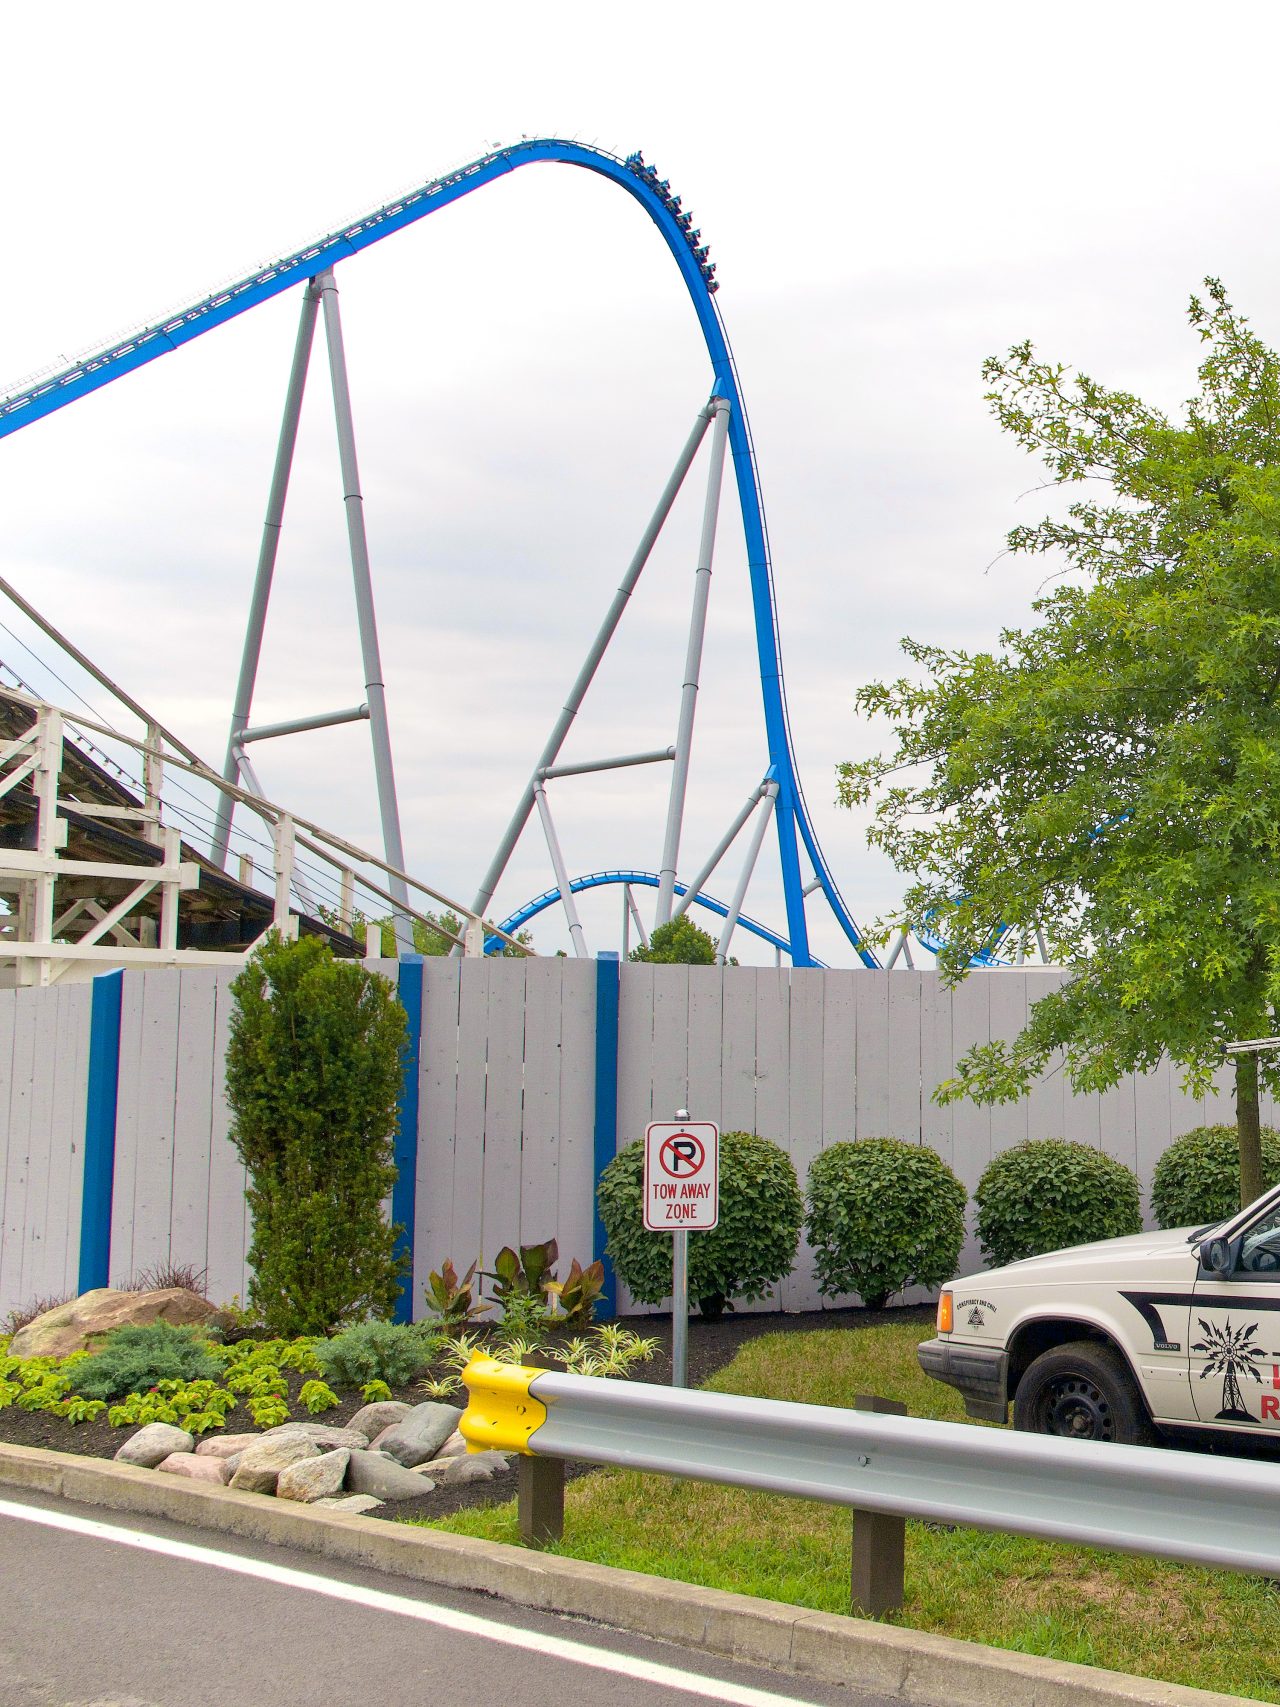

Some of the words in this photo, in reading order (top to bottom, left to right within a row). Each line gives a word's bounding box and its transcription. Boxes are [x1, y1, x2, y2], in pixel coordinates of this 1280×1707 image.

[653, 1184, 676, 1199] TOW
[680, 1183, 710, 1198] AWAY
[666, 1204, 697, 1219] ZONE
